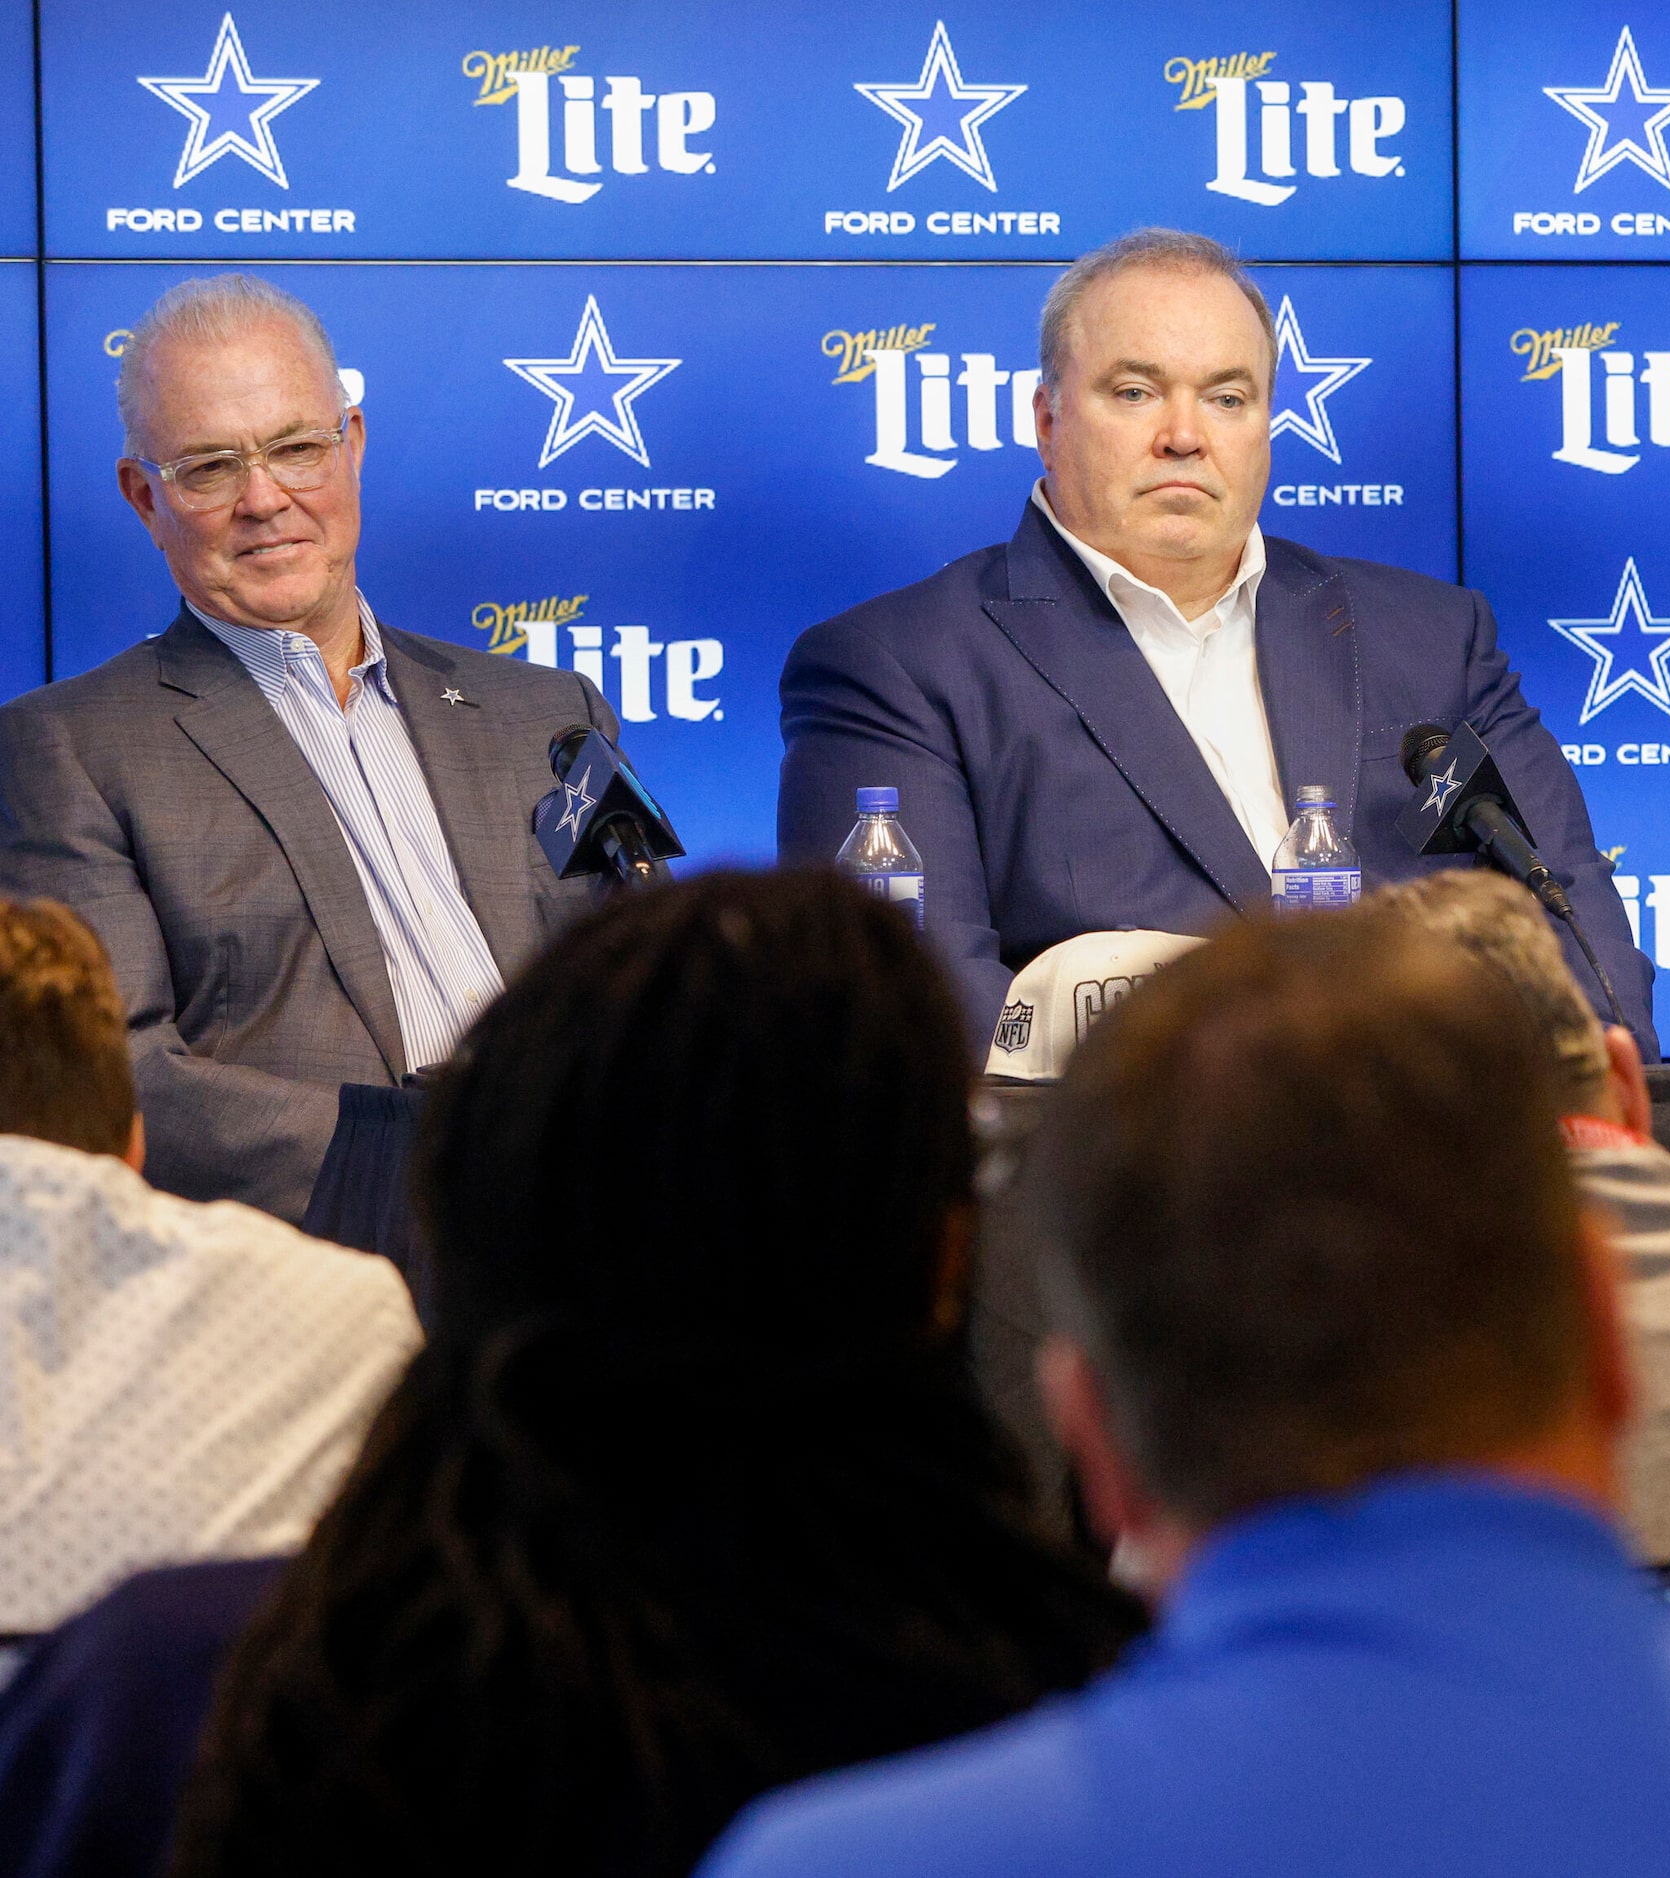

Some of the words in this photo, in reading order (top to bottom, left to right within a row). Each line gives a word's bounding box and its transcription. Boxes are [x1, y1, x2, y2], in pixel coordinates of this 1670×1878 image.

[462, 45, 581, 106] Miller
[1164, 51, 1277, 111] Miller
[107, 209, 202, 231] FORD
[214, 209, 355, 232] CENTER
[825, 212, 915, 234] FORD
[927, 212, 1060, 234] CENTER
[1514, 213, 1600, 235] FORD
[821, 323, 936, 385] Miller
[1512, 322, 1620, 381] Miller
[475, 490, 566, 510] FORD
[579, 489, 714, 509] CENTER
[1274, 486, 1402, 505] CENTER
[472, 594, 589, 654] Miller
[1561, 745, 1605, 764] RD
[998, 1022, 1026, 1048] NFL
